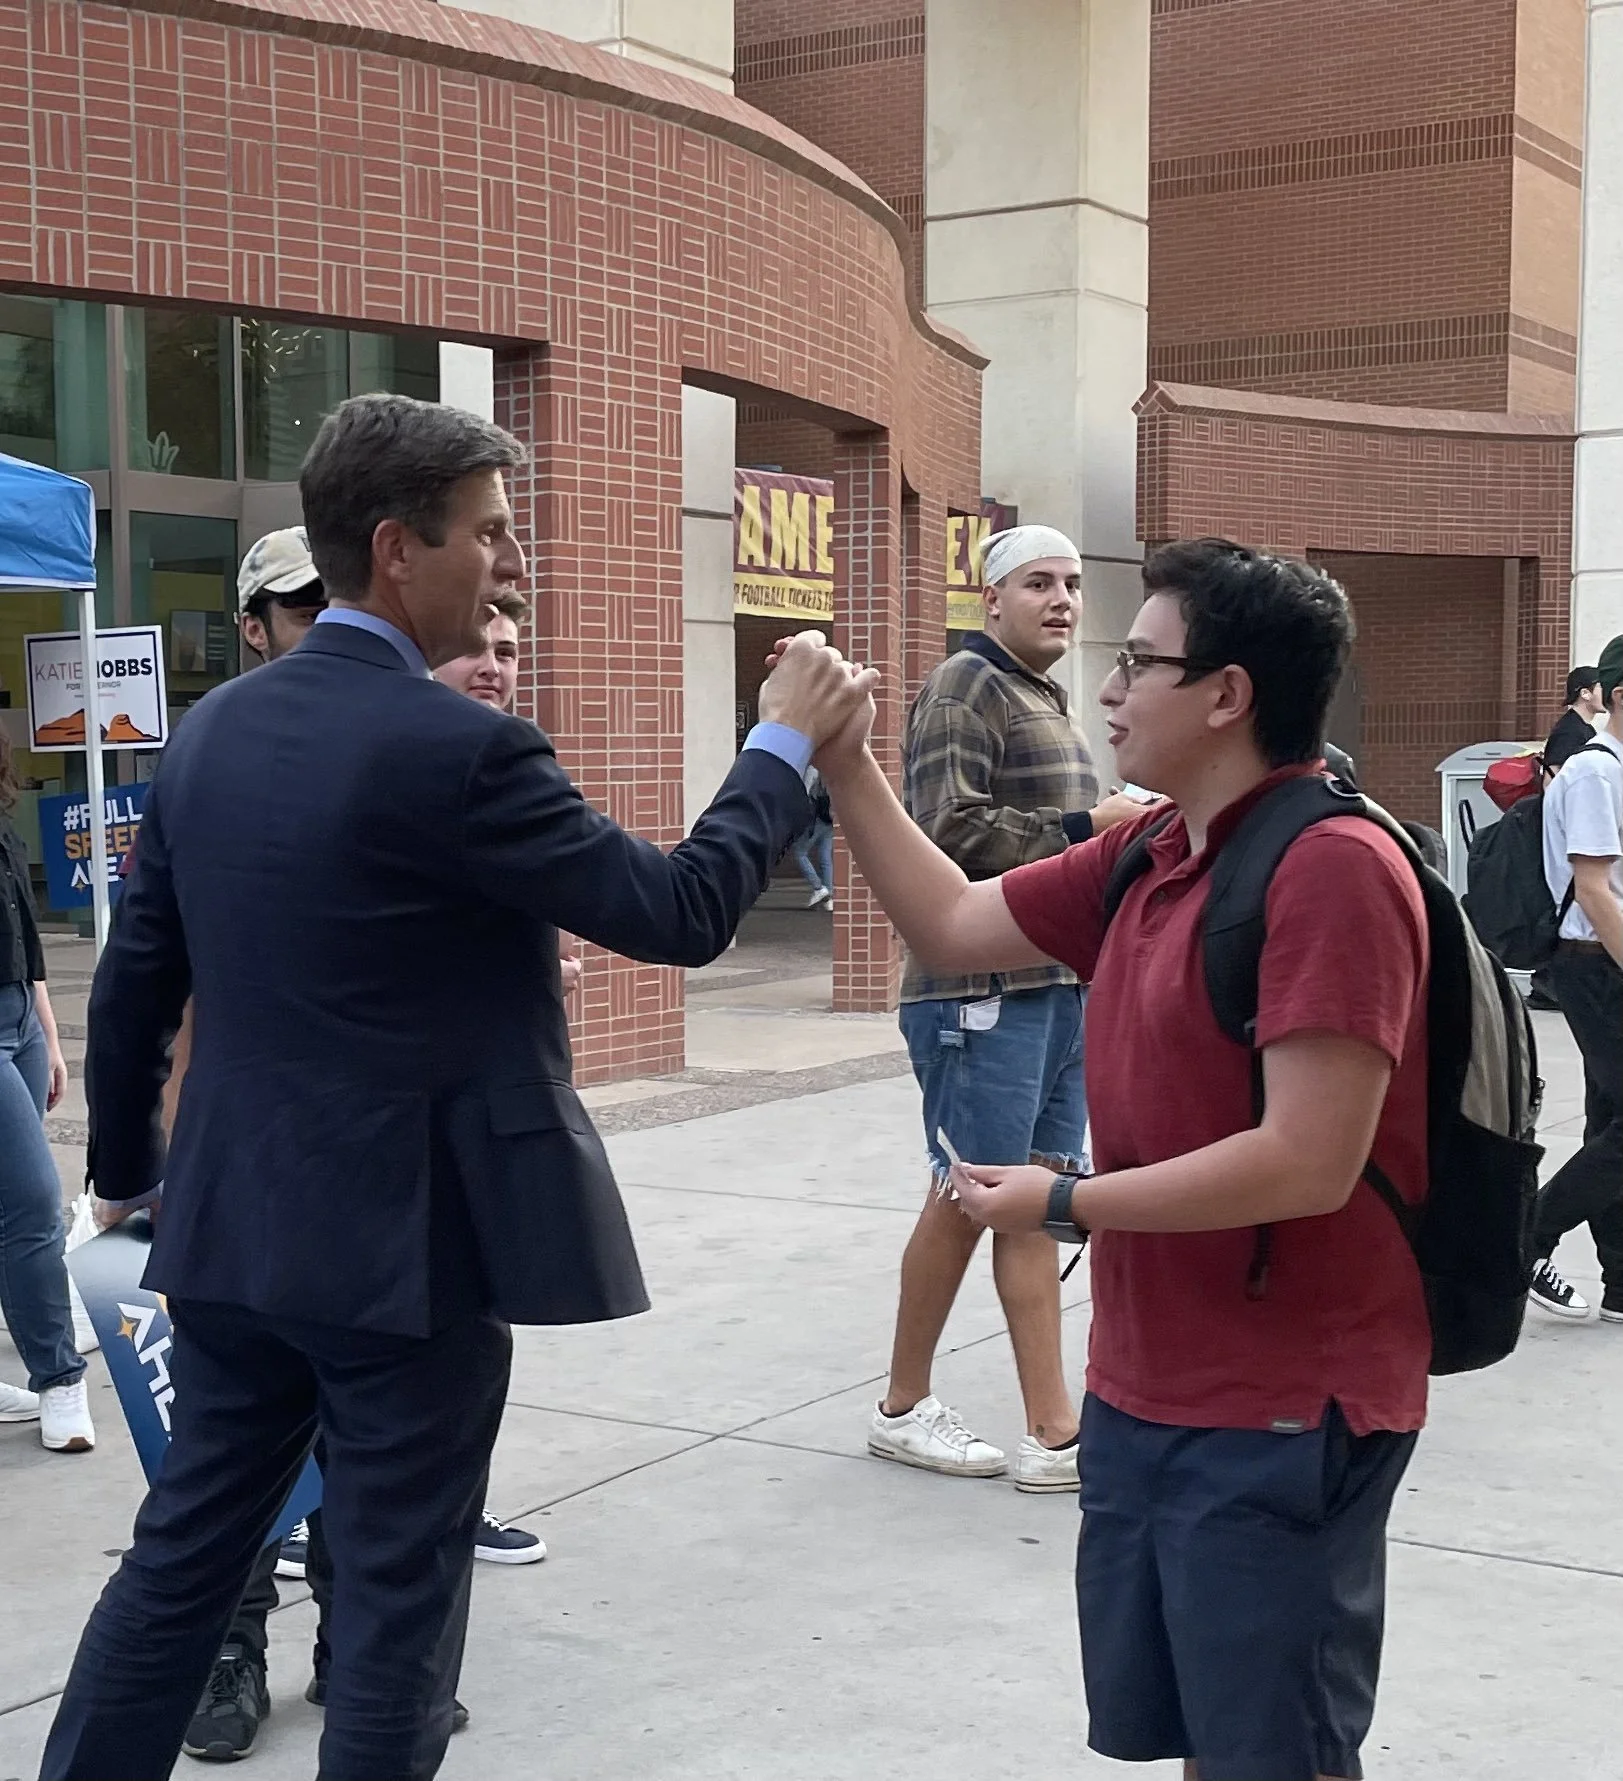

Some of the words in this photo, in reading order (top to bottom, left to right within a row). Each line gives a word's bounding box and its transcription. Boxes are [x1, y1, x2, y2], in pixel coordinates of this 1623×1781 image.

[738, 485, 833, 574] AME
[946, 516, 991, 586] EK
[742, 583, 786, 608] FOOTBALL
[789, 587, 822, 610] TICKETS
[35, 661, 82, 681] KATIE
